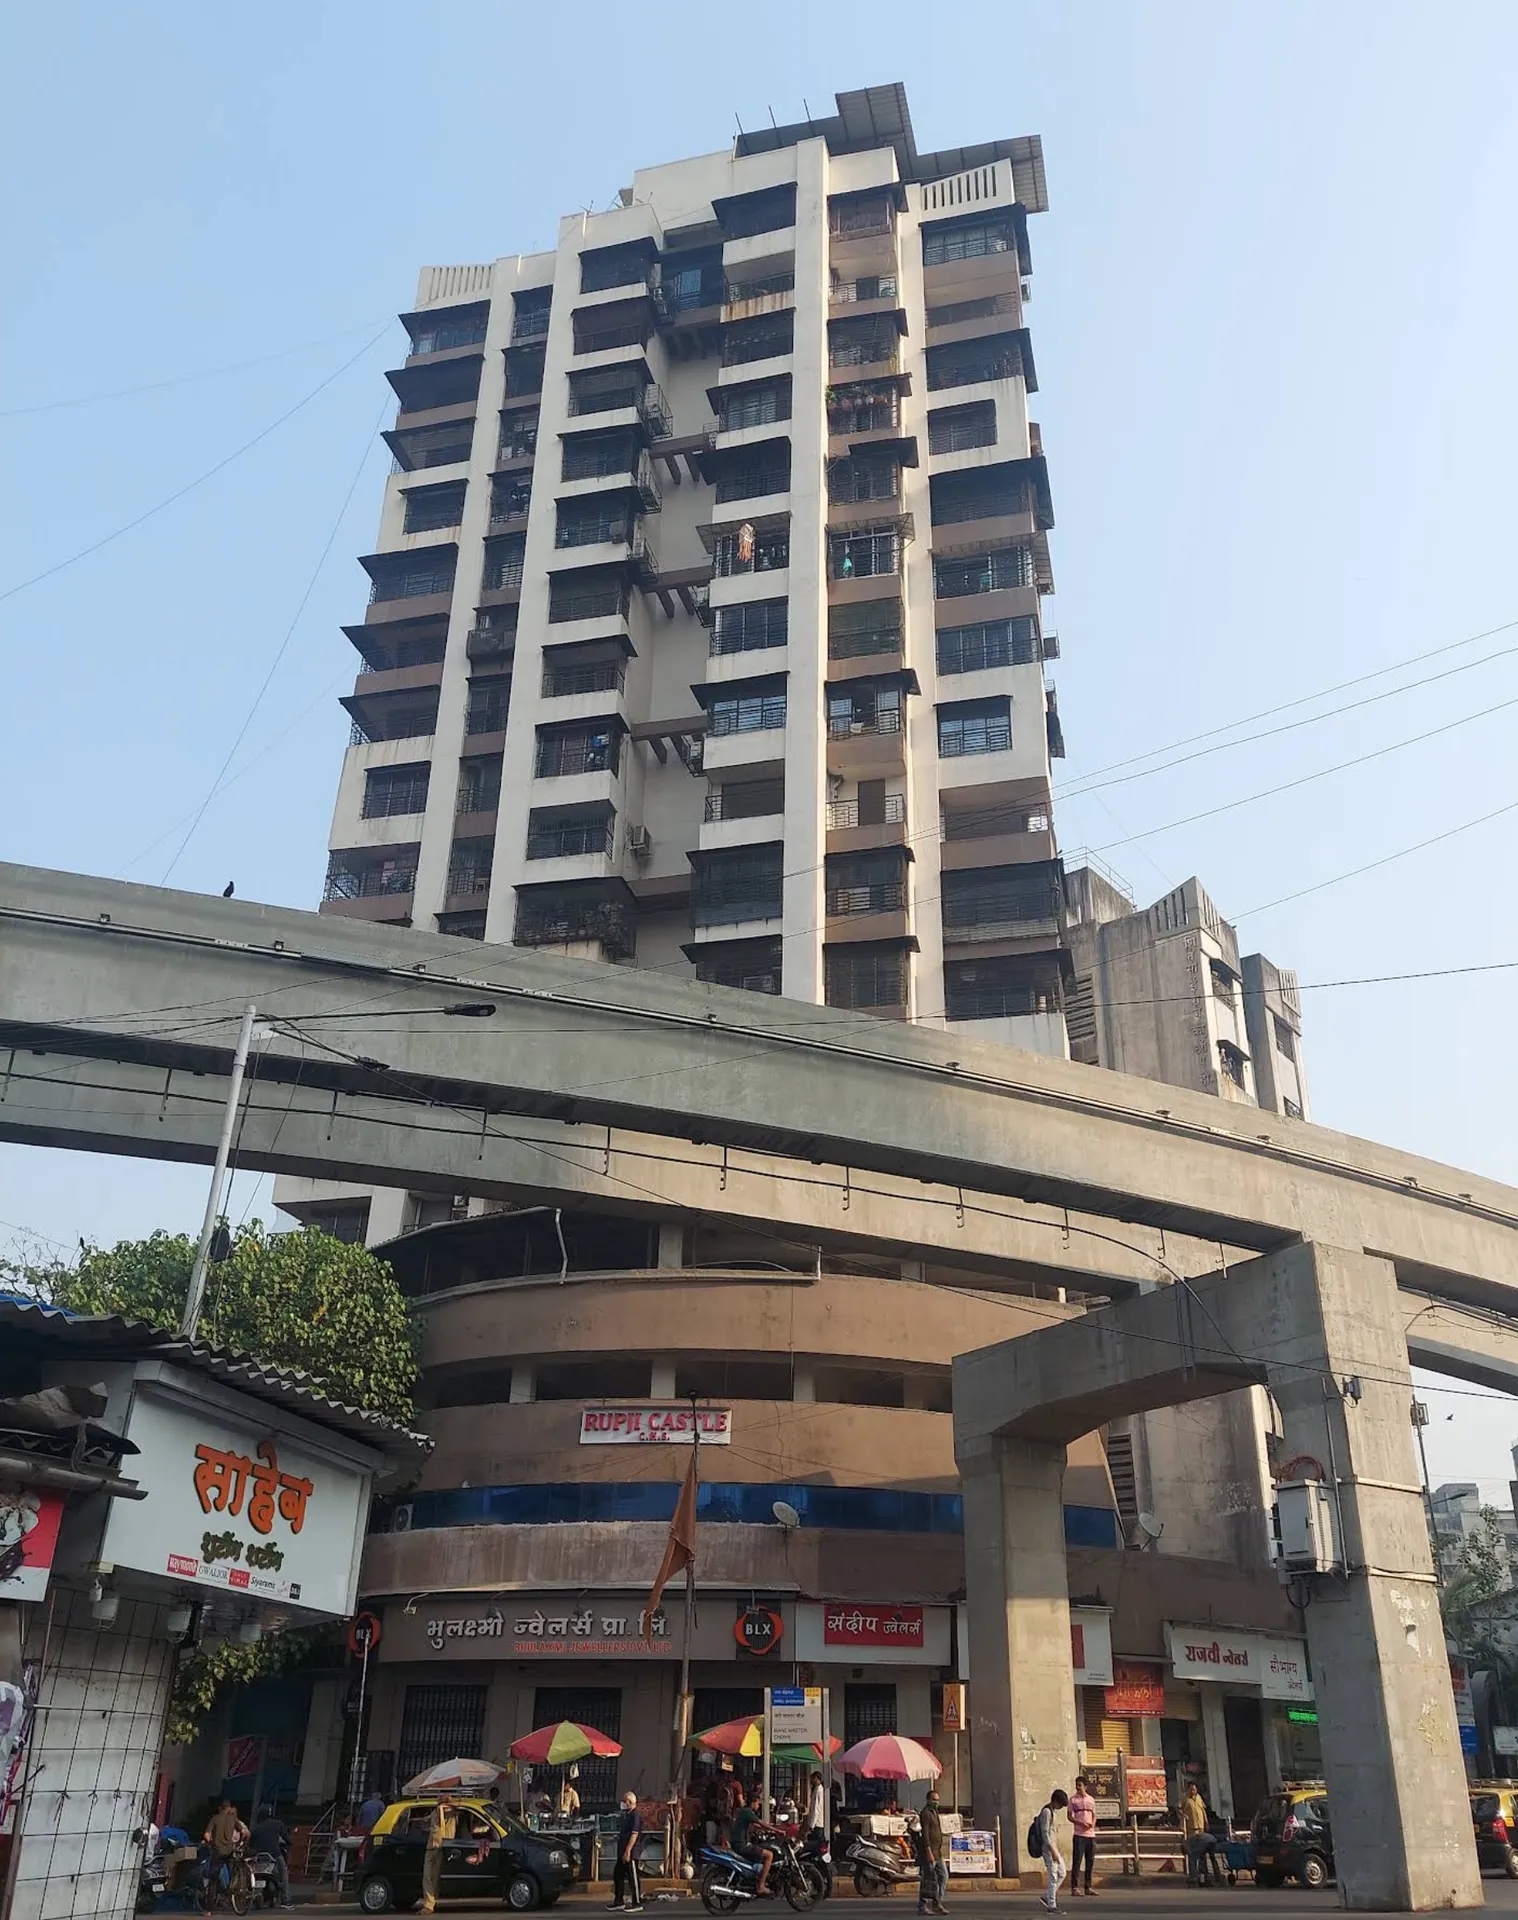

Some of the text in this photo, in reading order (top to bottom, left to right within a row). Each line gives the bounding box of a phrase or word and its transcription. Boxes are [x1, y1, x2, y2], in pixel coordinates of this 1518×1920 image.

[584, 1412, 728, 1434] RUPJI CASTLE
[193, 1441, 314, 1535] साहेब
[513, 1609, 593, 1636] ज्वेलर्स
[745, 1623, 771, 1635] BLX
[827, 1610, 922, 1635] संदीप ज्वेलर्स
[569, 1641, 627, 1653] JEWELLERS
[1184, 1641, 1249, 1666] राजवी ज्वेलर्स
[1270, 1654, 1298, 1675] सौभाग्य
